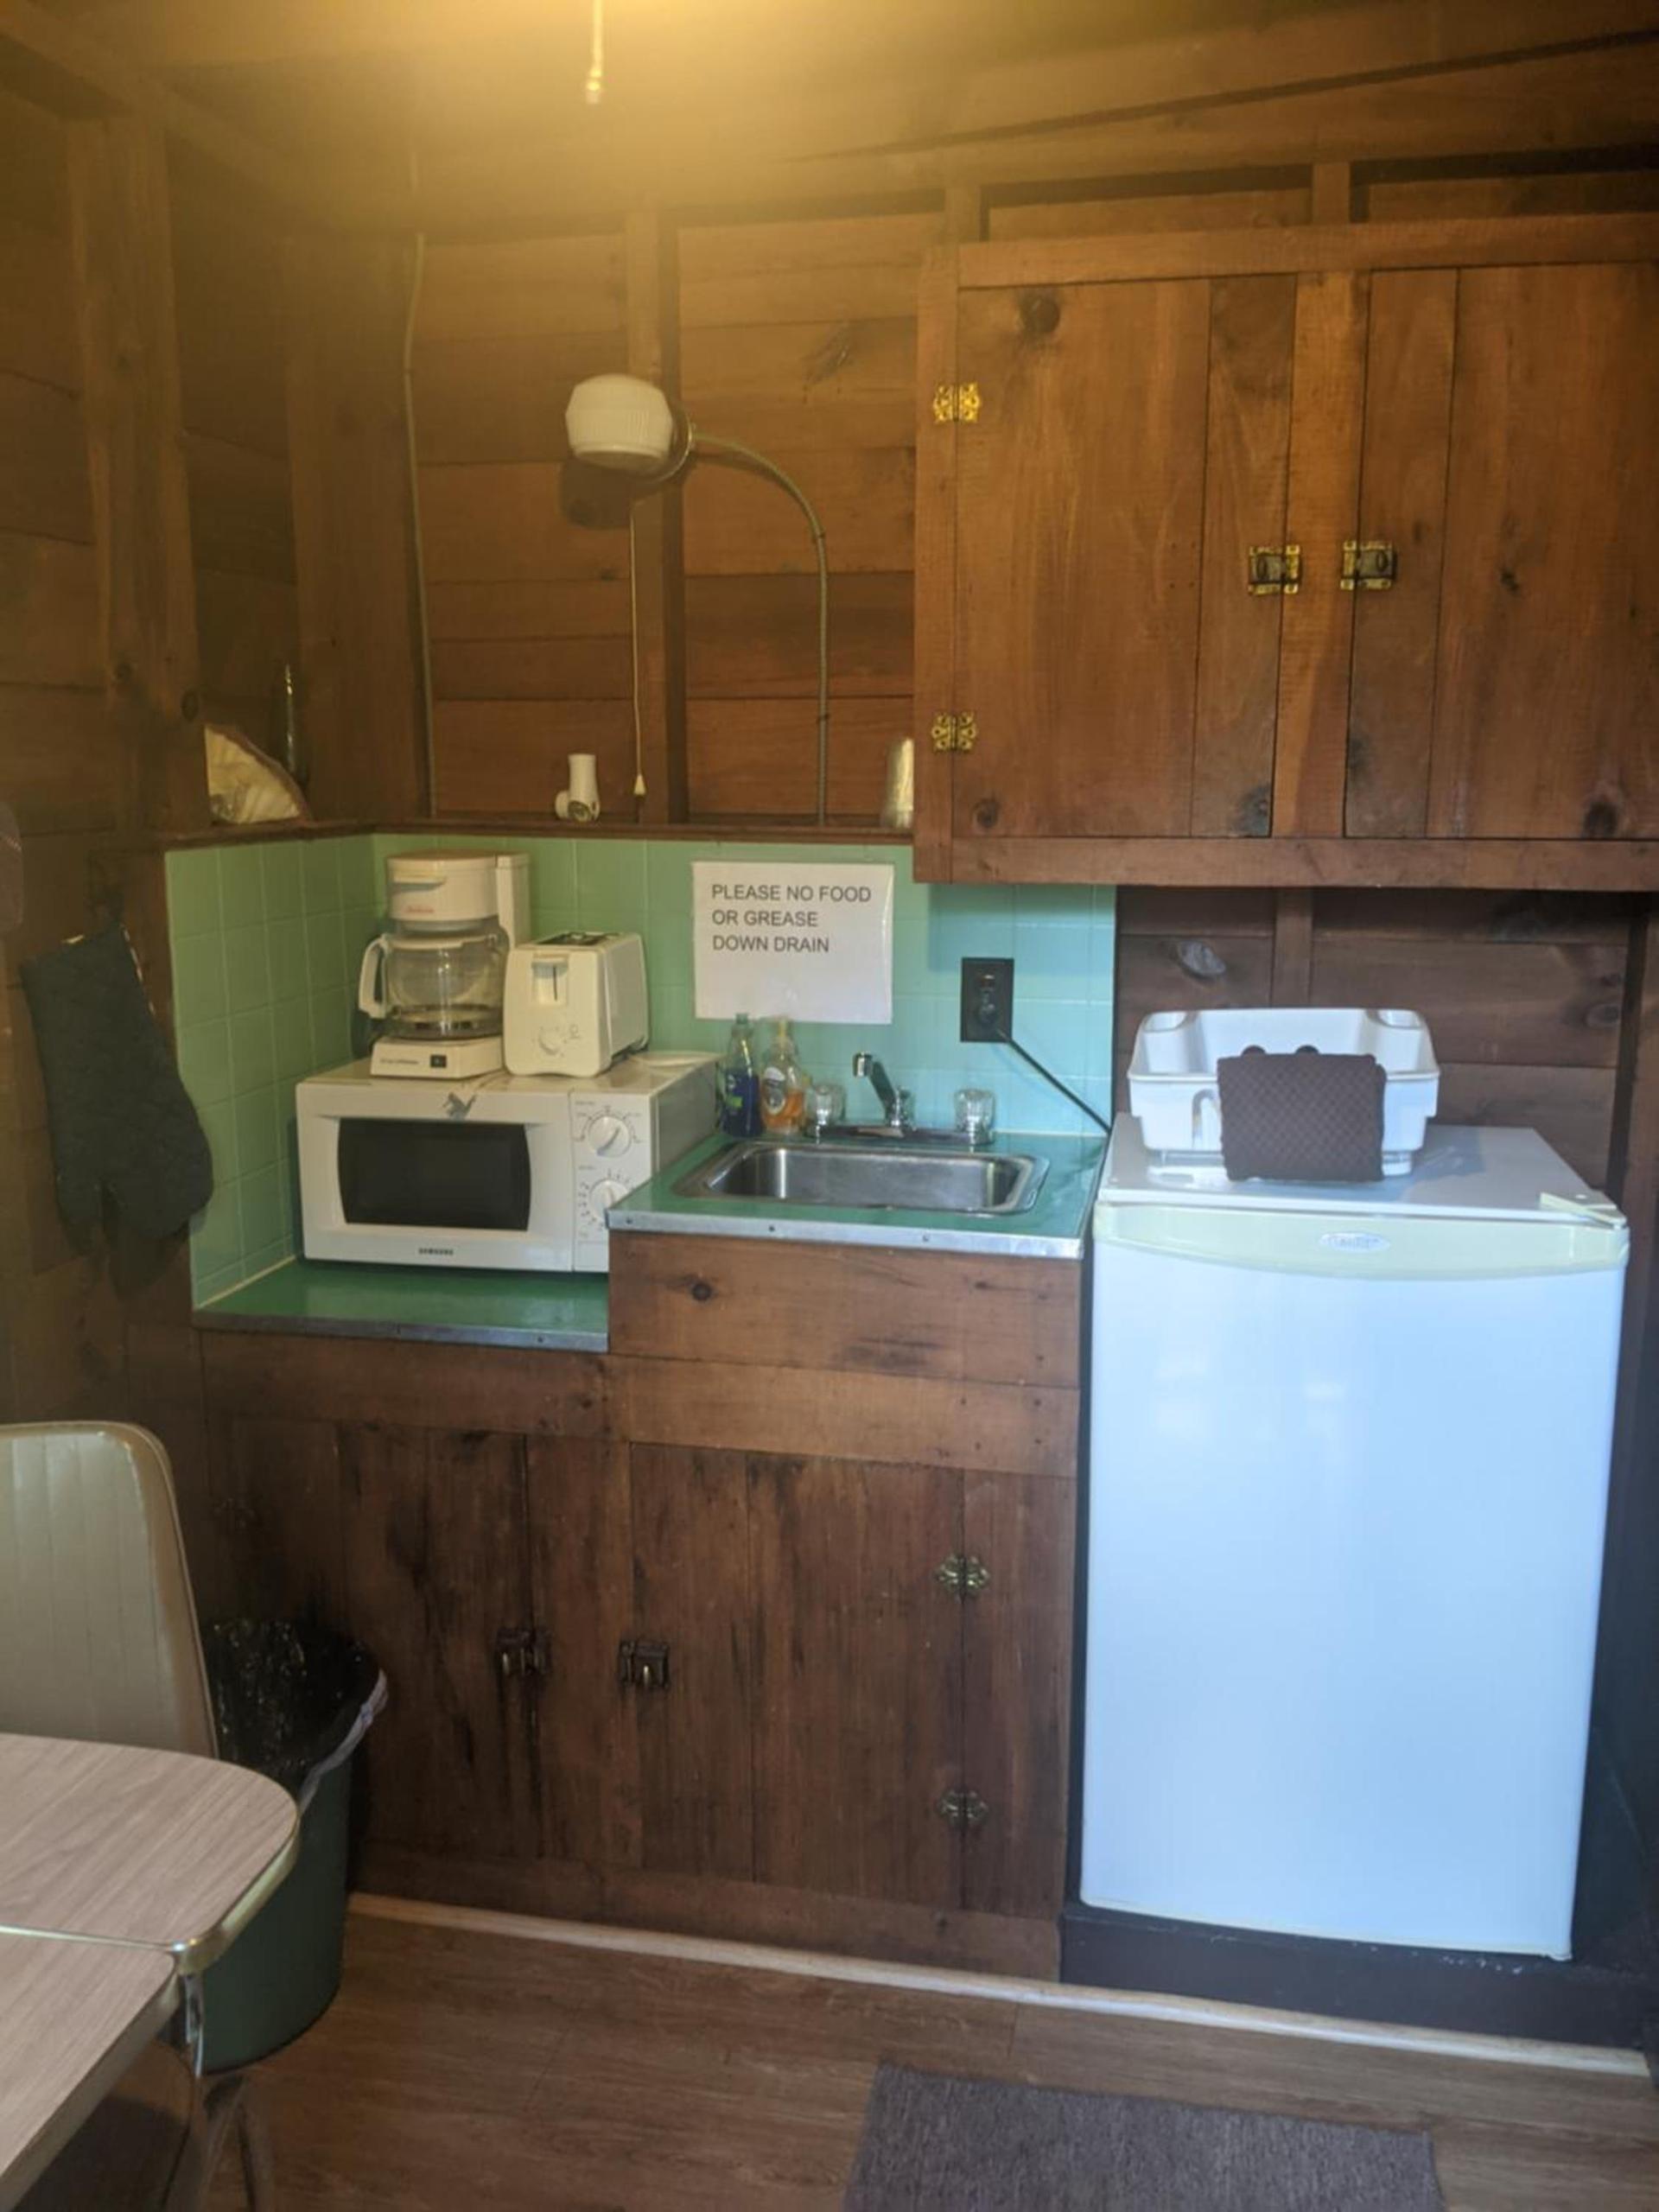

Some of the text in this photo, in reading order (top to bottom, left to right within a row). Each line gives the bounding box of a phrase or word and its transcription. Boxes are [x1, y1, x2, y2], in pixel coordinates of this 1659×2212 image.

[712, 884, 871, 902] PLEASE NO FOOD
[712, 909, 818, 927] OR GREASE
[713, 934, 830, 952] DOWN DRAIN
